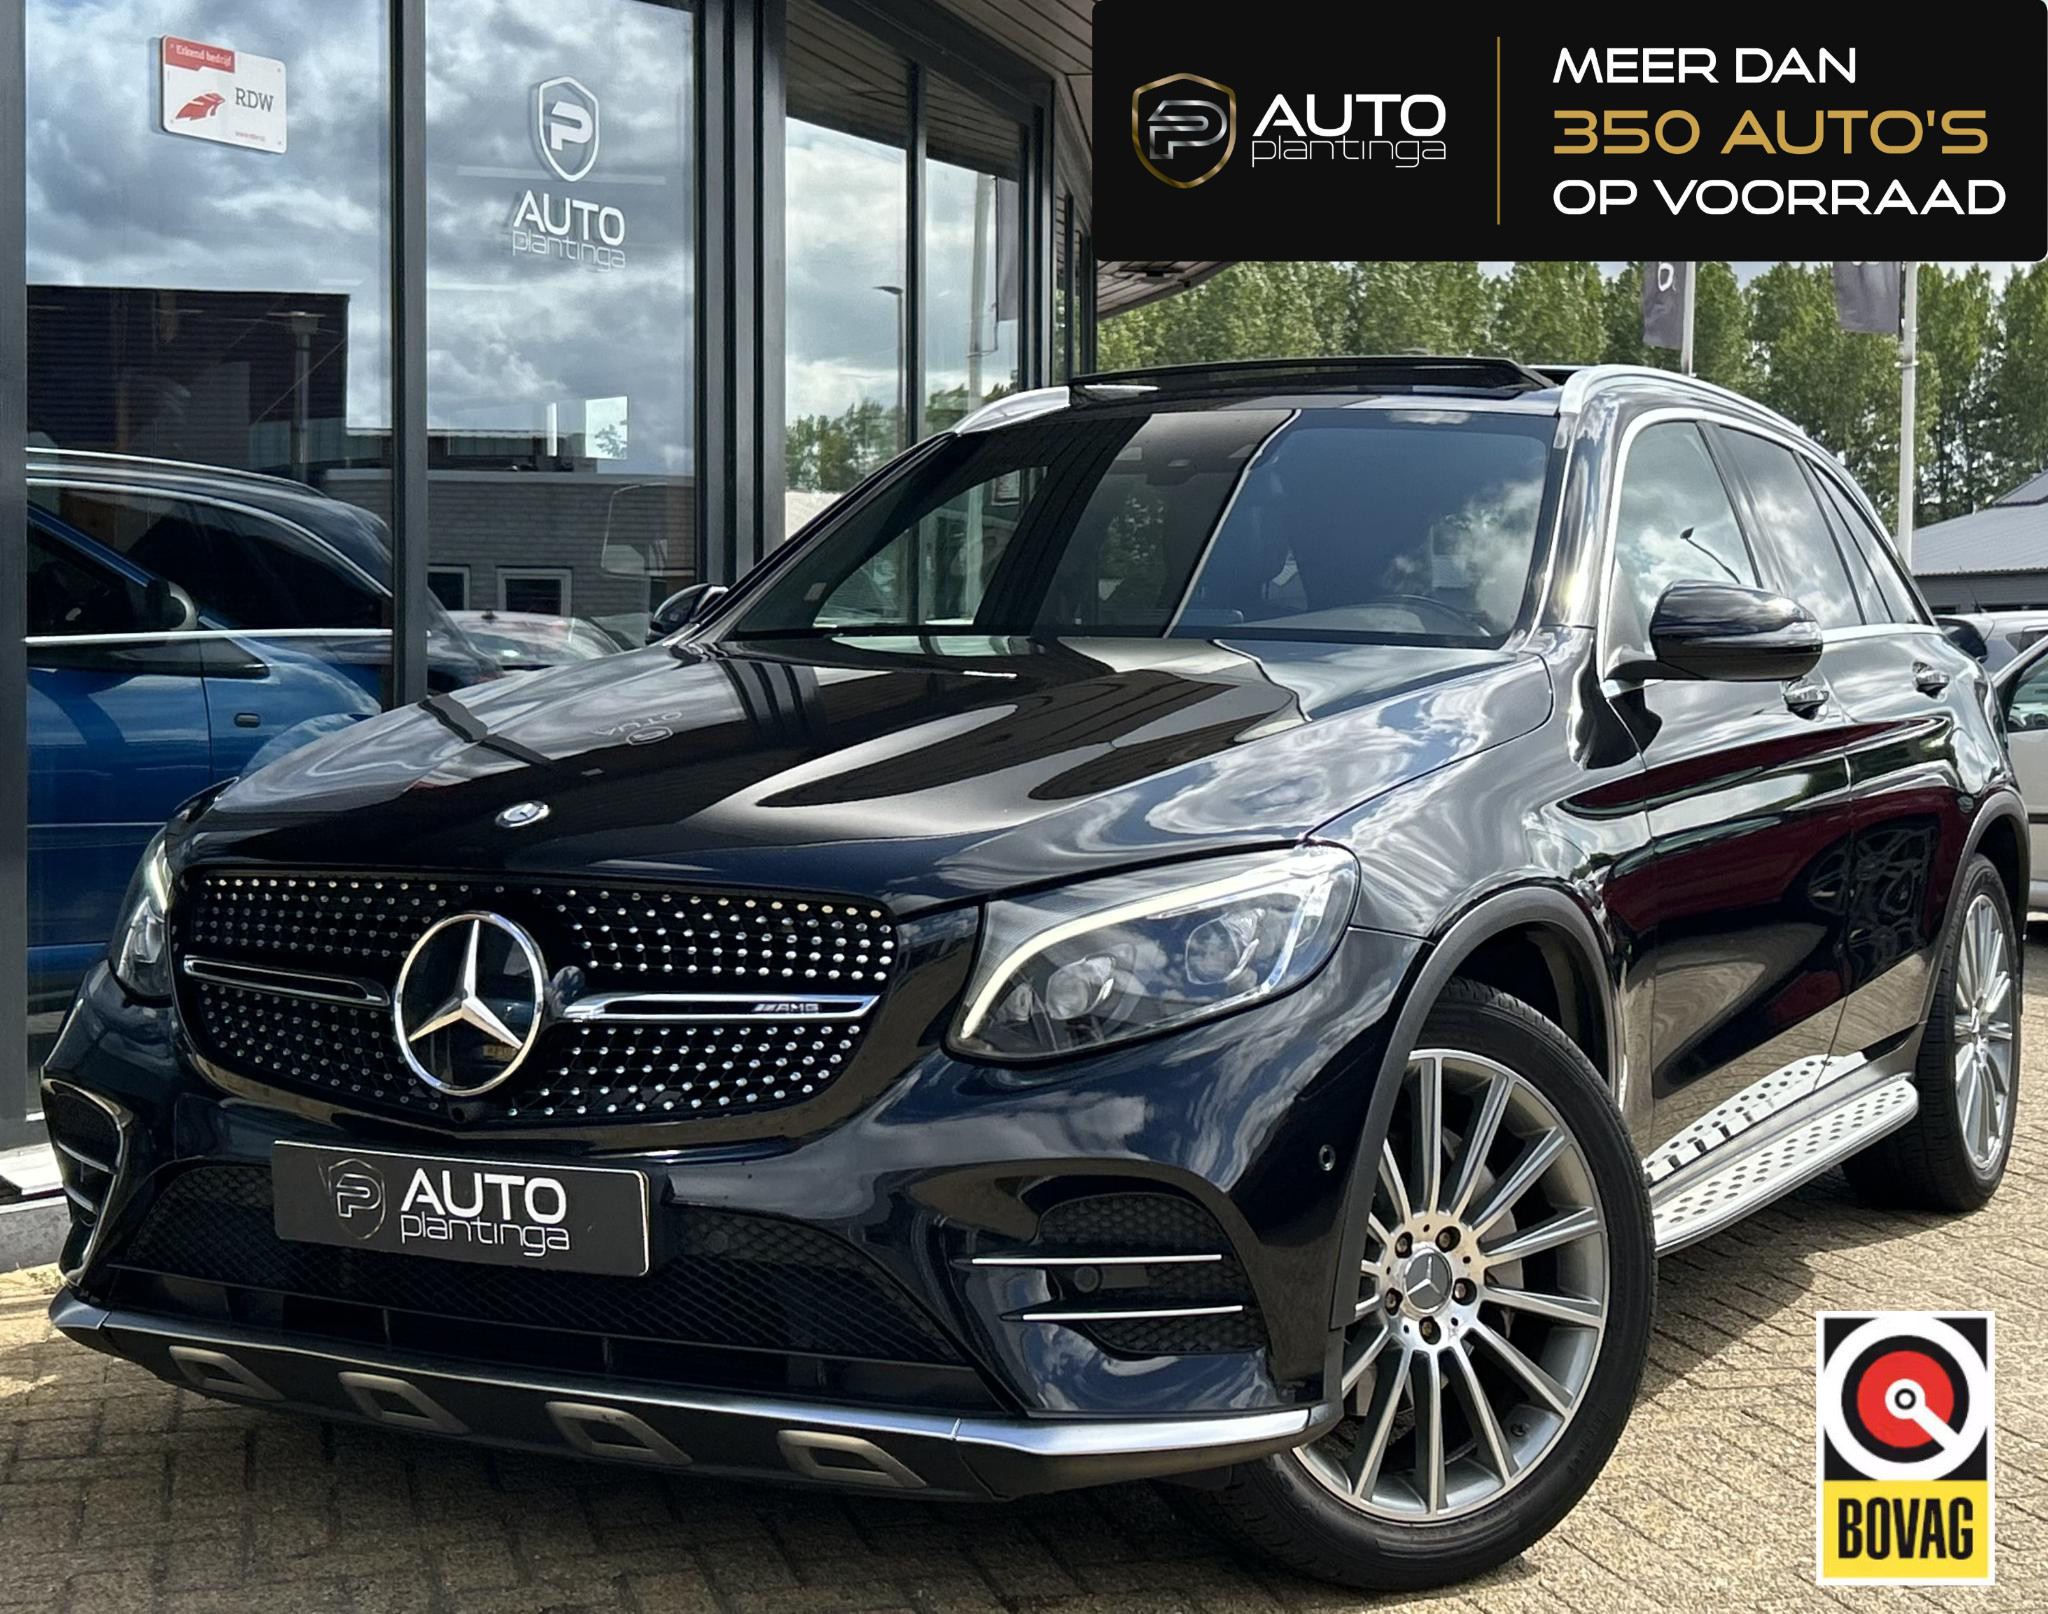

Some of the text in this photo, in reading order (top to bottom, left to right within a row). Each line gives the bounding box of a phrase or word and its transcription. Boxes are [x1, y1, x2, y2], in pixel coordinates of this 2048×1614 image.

[235, 87, 274, 112] RDW
[513, 190, 625, 246] AUTO
[512, 229, 626, 272] plantinga
[774, 1003, 819, 1013] AMG
[400, 1167, 567, 1225] AUTO
[401, 1210, 570, 1257] plantinga
